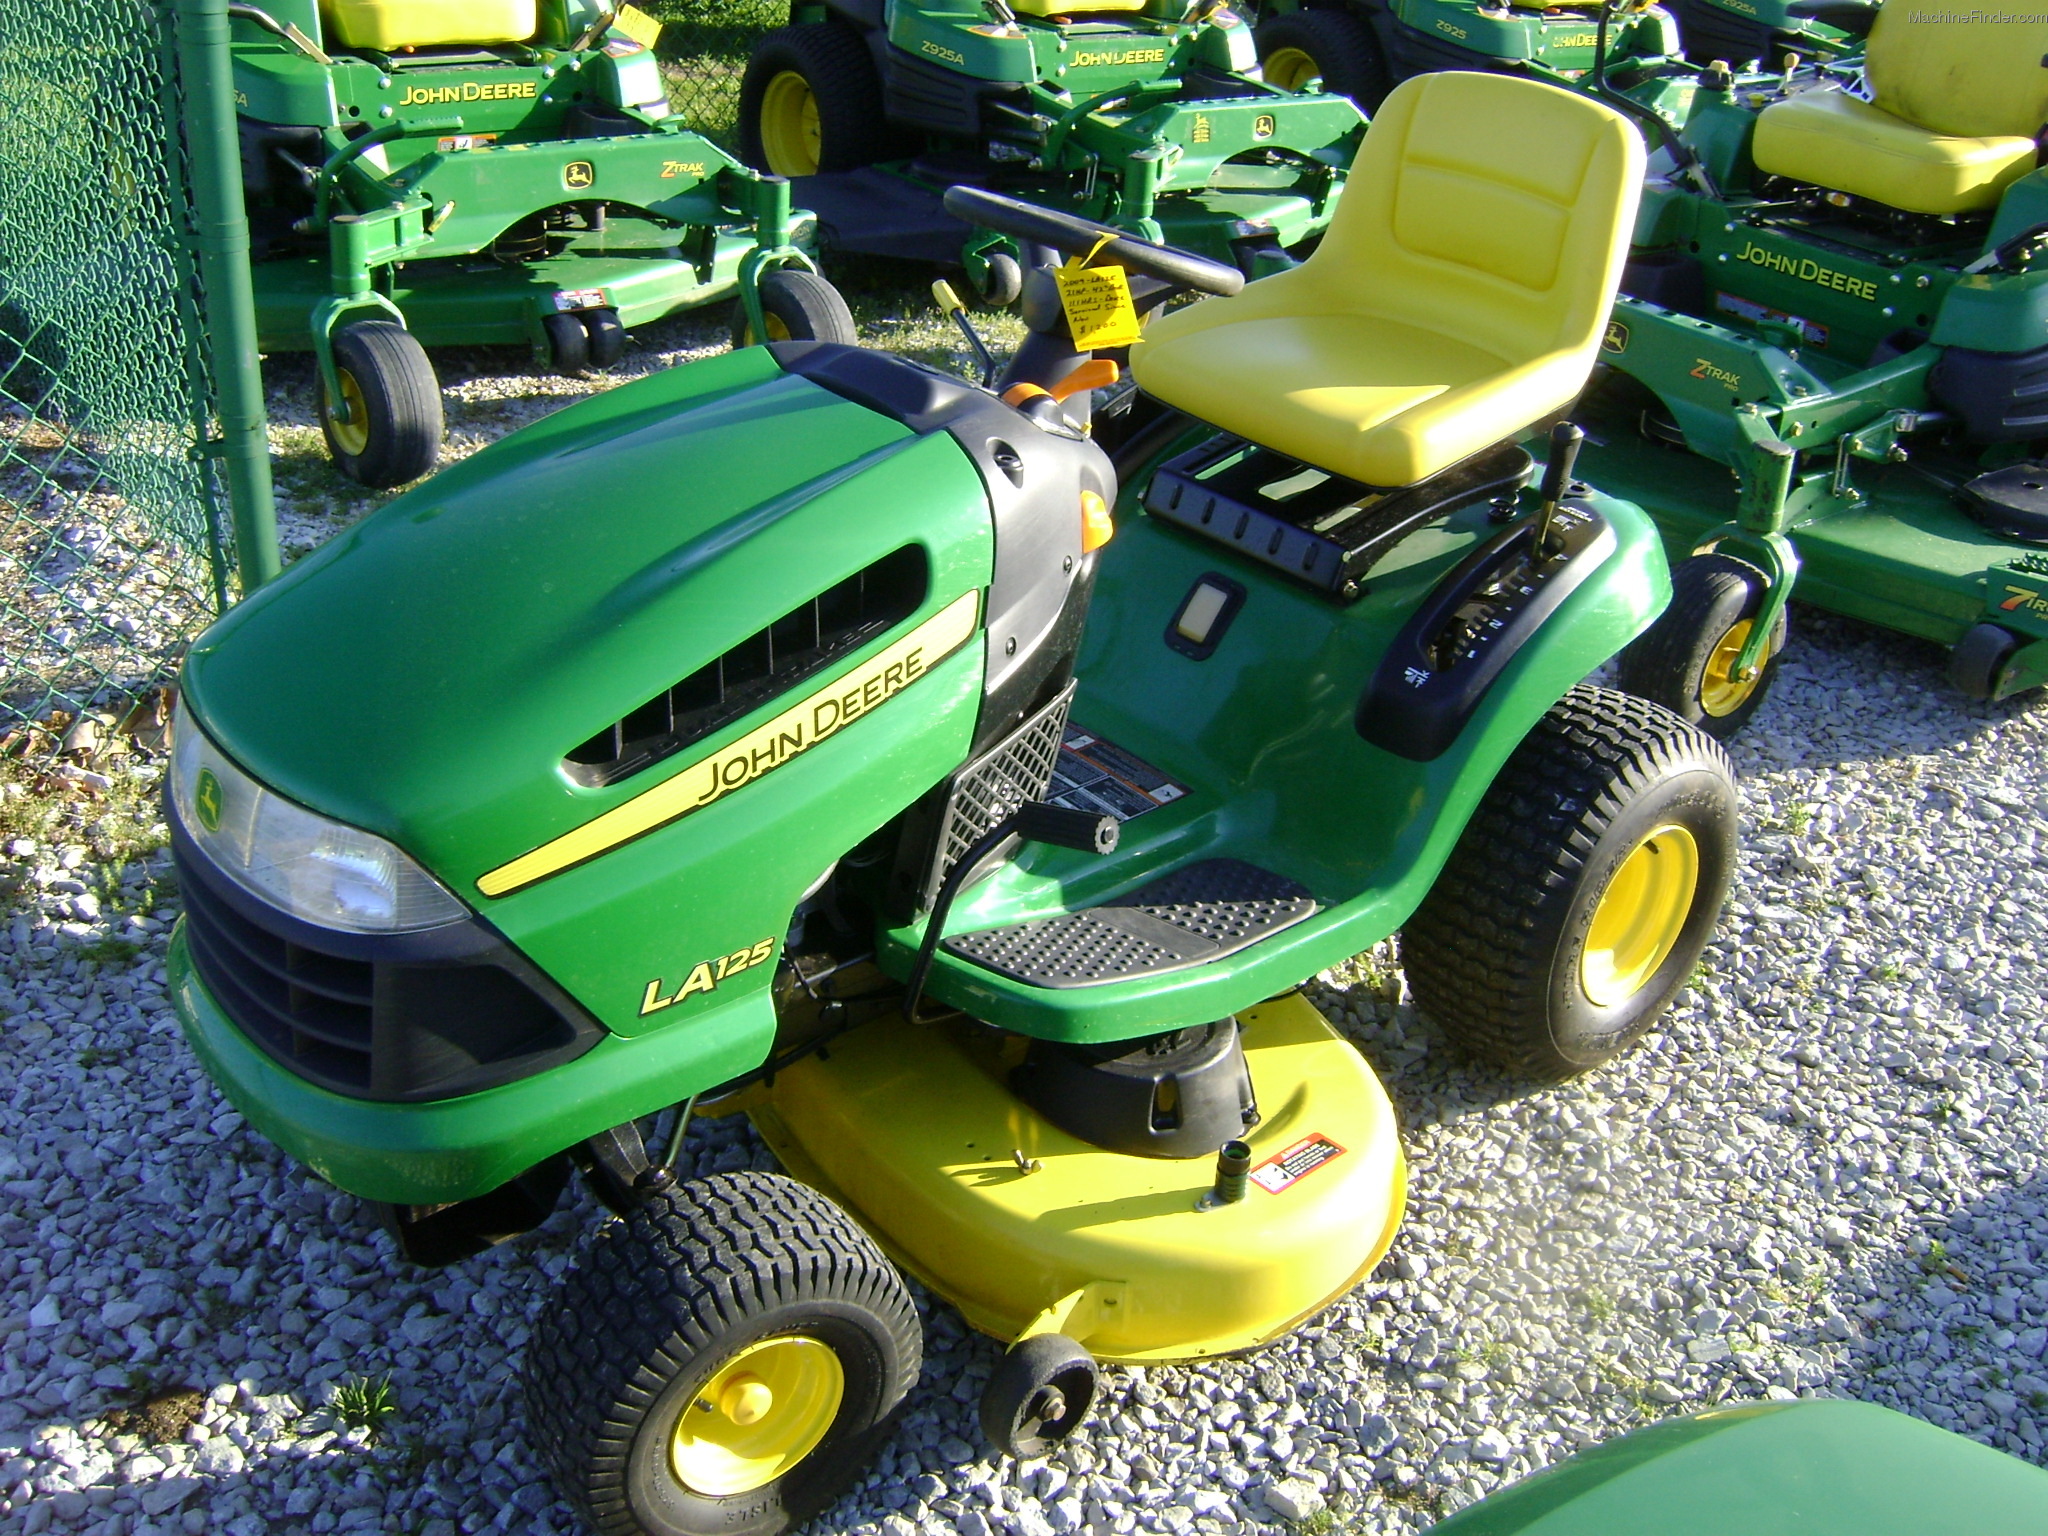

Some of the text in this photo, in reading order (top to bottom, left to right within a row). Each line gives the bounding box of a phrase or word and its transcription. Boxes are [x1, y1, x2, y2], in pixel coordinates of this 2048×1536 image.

[1436, 20, 1467, 40] Z925
[1576, 33, 1613, 47] DEEE
[921, 40, 965, 66] Z925A
[1069, 49, 1164, 67] JOHN DEERE
[400, 82, 536, 106] JOHN DEERE
[1736, 241, 1878, 301] JOHN DEERE
[1690, 358, 1740, 386] ZTRAK
[2000, 584, 2048, 612] 7IR
[698, 647, 923, 802] JOHN DEERE
[638, 935, 776, 1018] LA125
